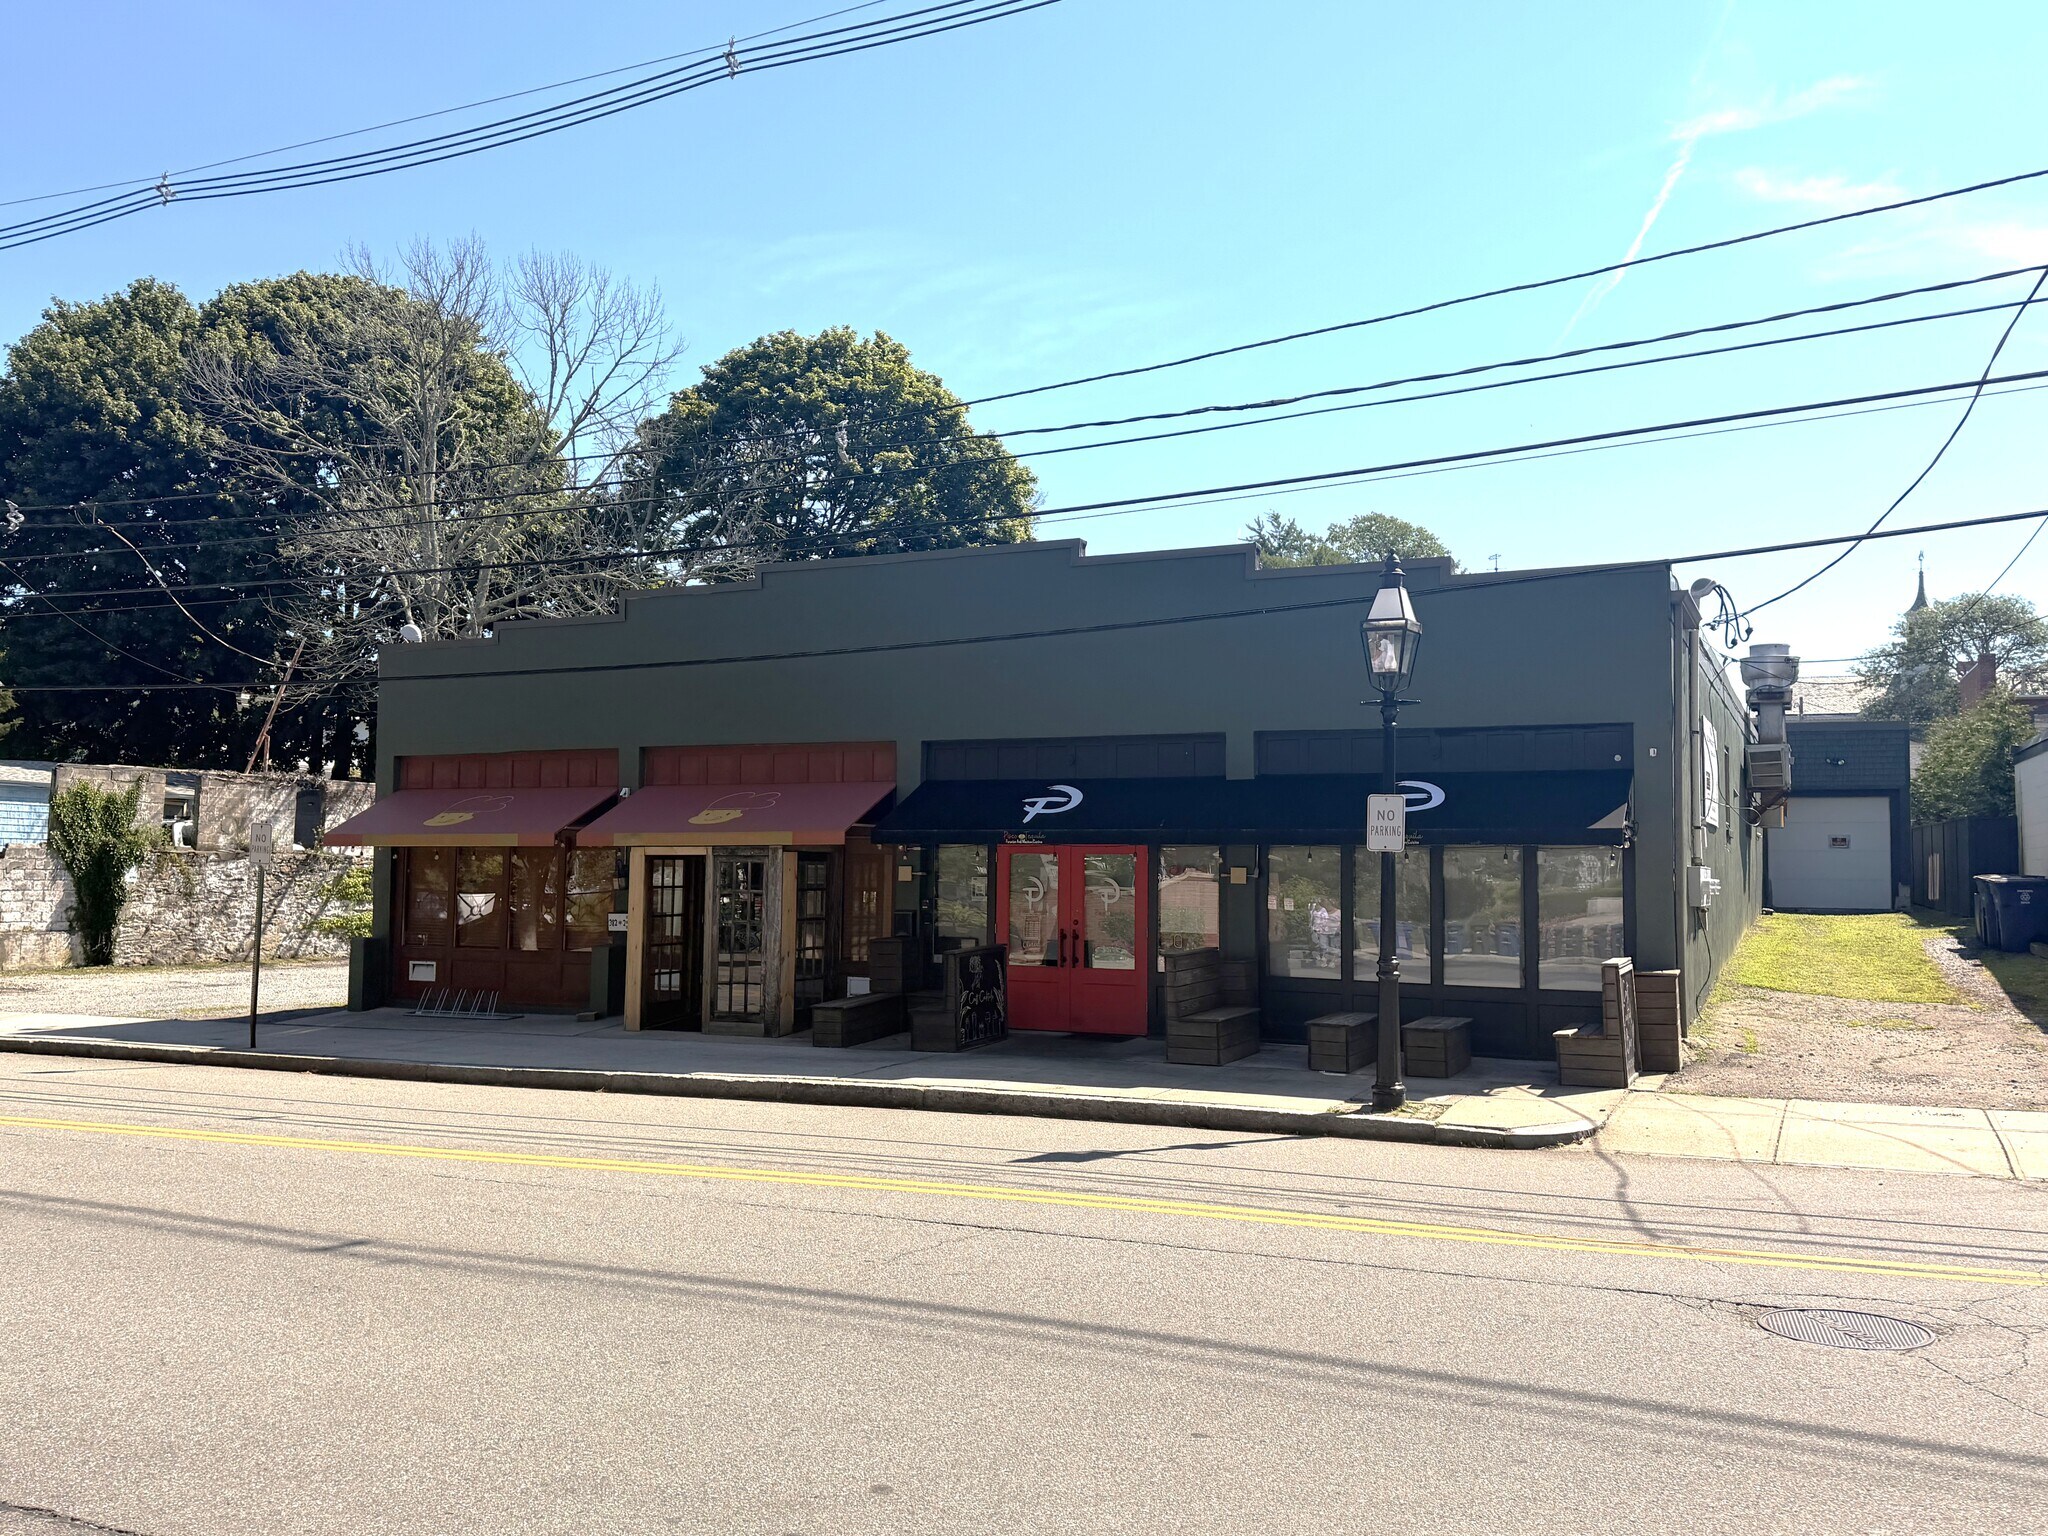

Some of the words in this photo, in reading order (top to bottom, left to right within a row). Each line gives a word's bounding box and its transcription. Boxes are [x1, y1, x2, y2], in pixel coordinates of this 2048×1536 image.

[1377, 809, 1395, 821] NO
[1370, 825, 1402, 837] PARKING
[255, 833, 267, 843] NO
